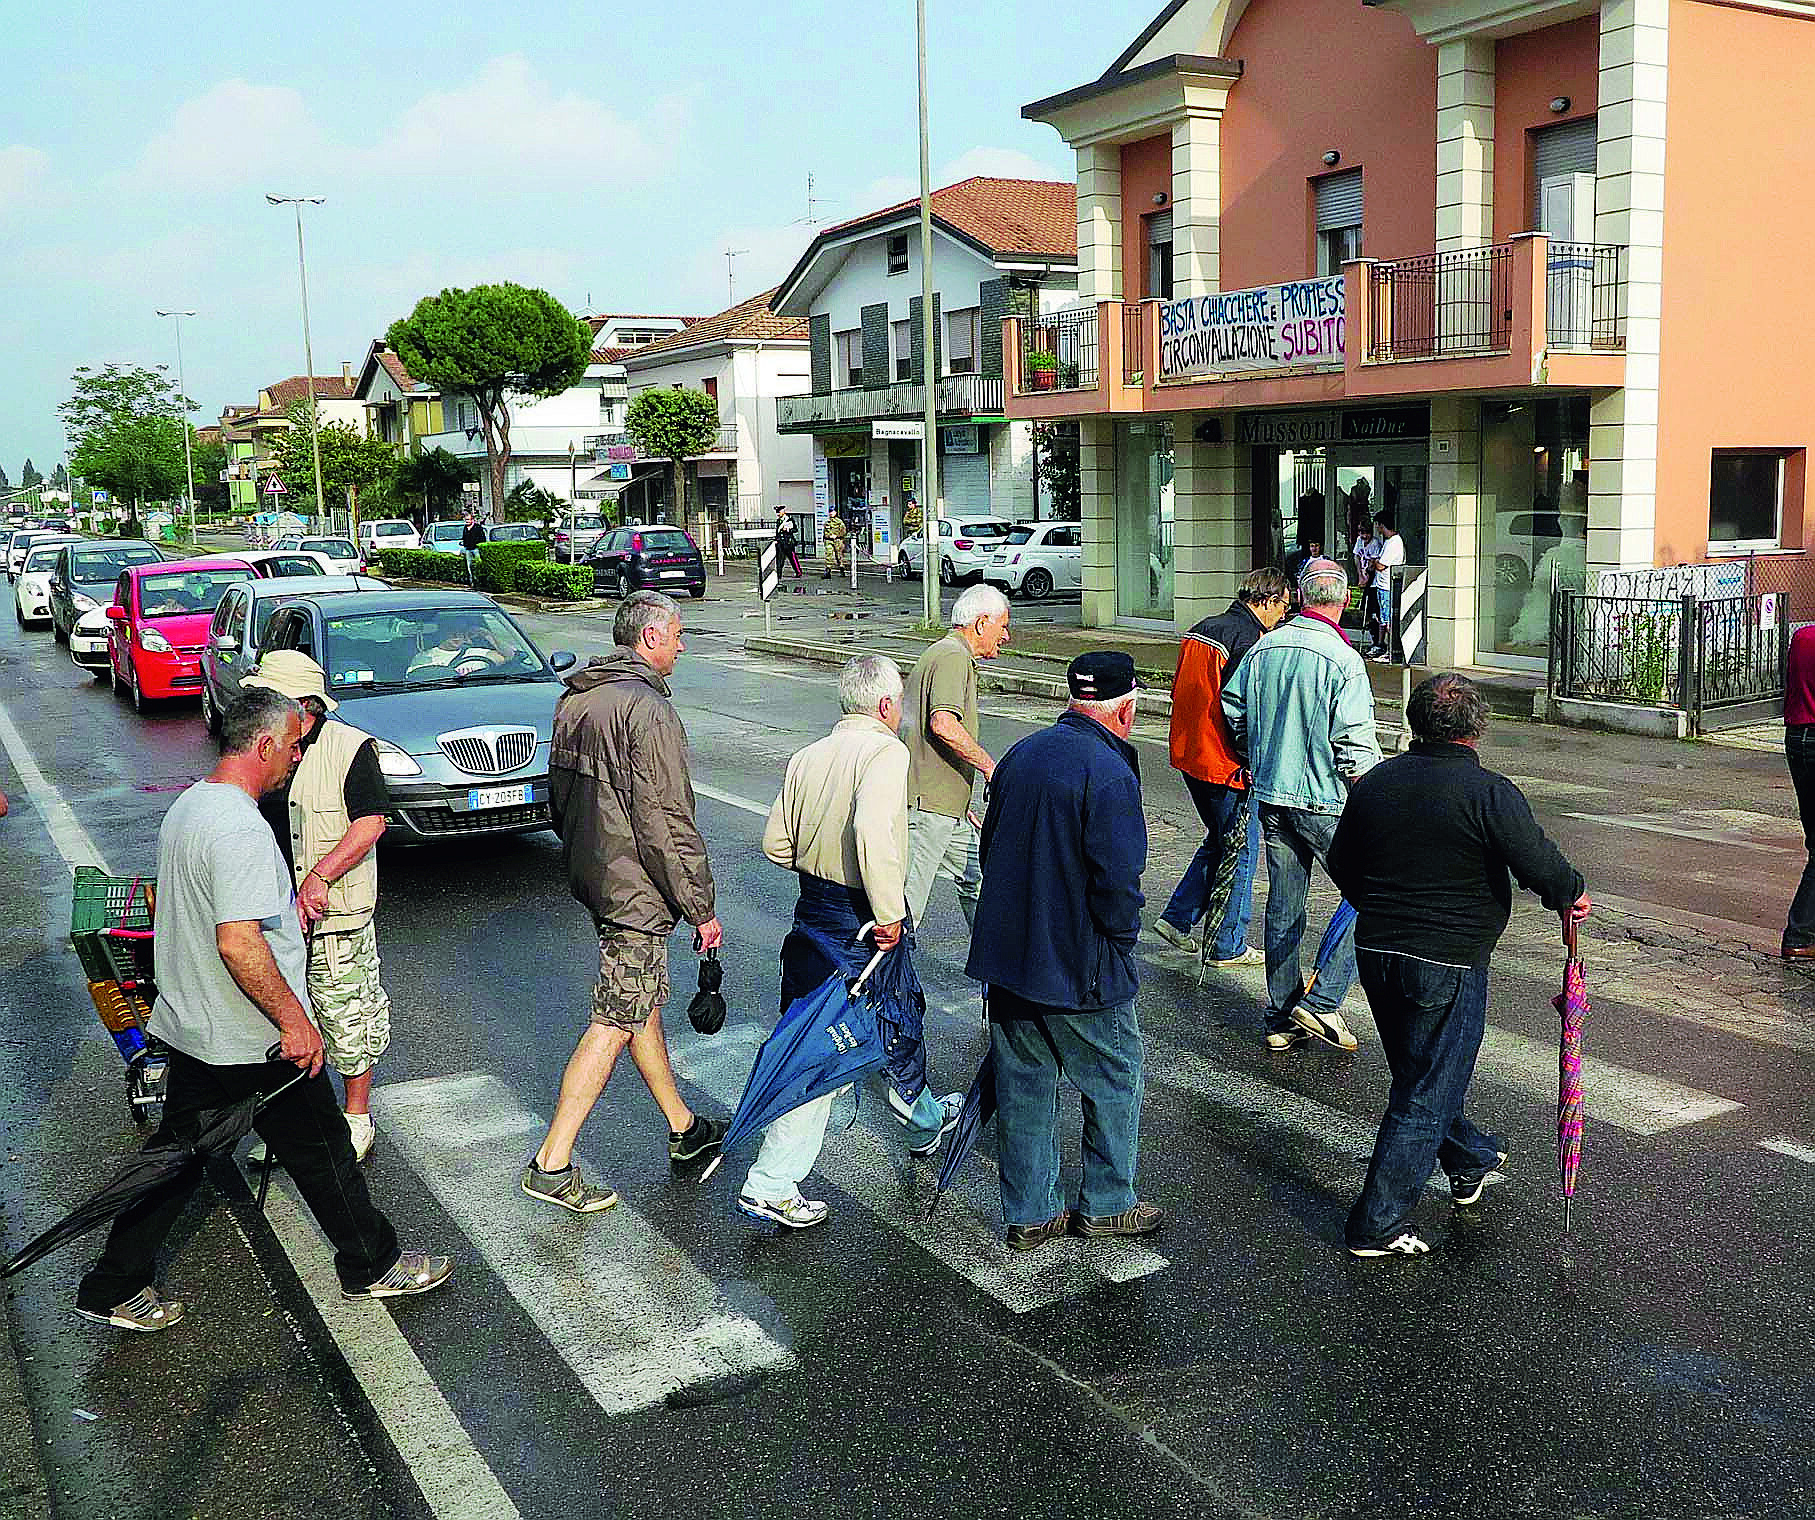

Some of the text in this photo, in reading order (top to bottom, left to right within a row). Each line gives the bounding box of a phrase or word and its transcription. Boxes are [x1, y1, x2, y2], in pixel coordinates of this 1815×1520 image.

[1160, 299, 1196, 336] BASTA
[1281, 279, 1344, 320] PROMESS
[1161, 316, 1345, 375] CIRCONVALLAZIONE SUBITO
[875, 428, 920, 436] Bagnacavallo
[1240, 415, 1336, 443] Mussoni
[479, 792, 490, 806] CY
